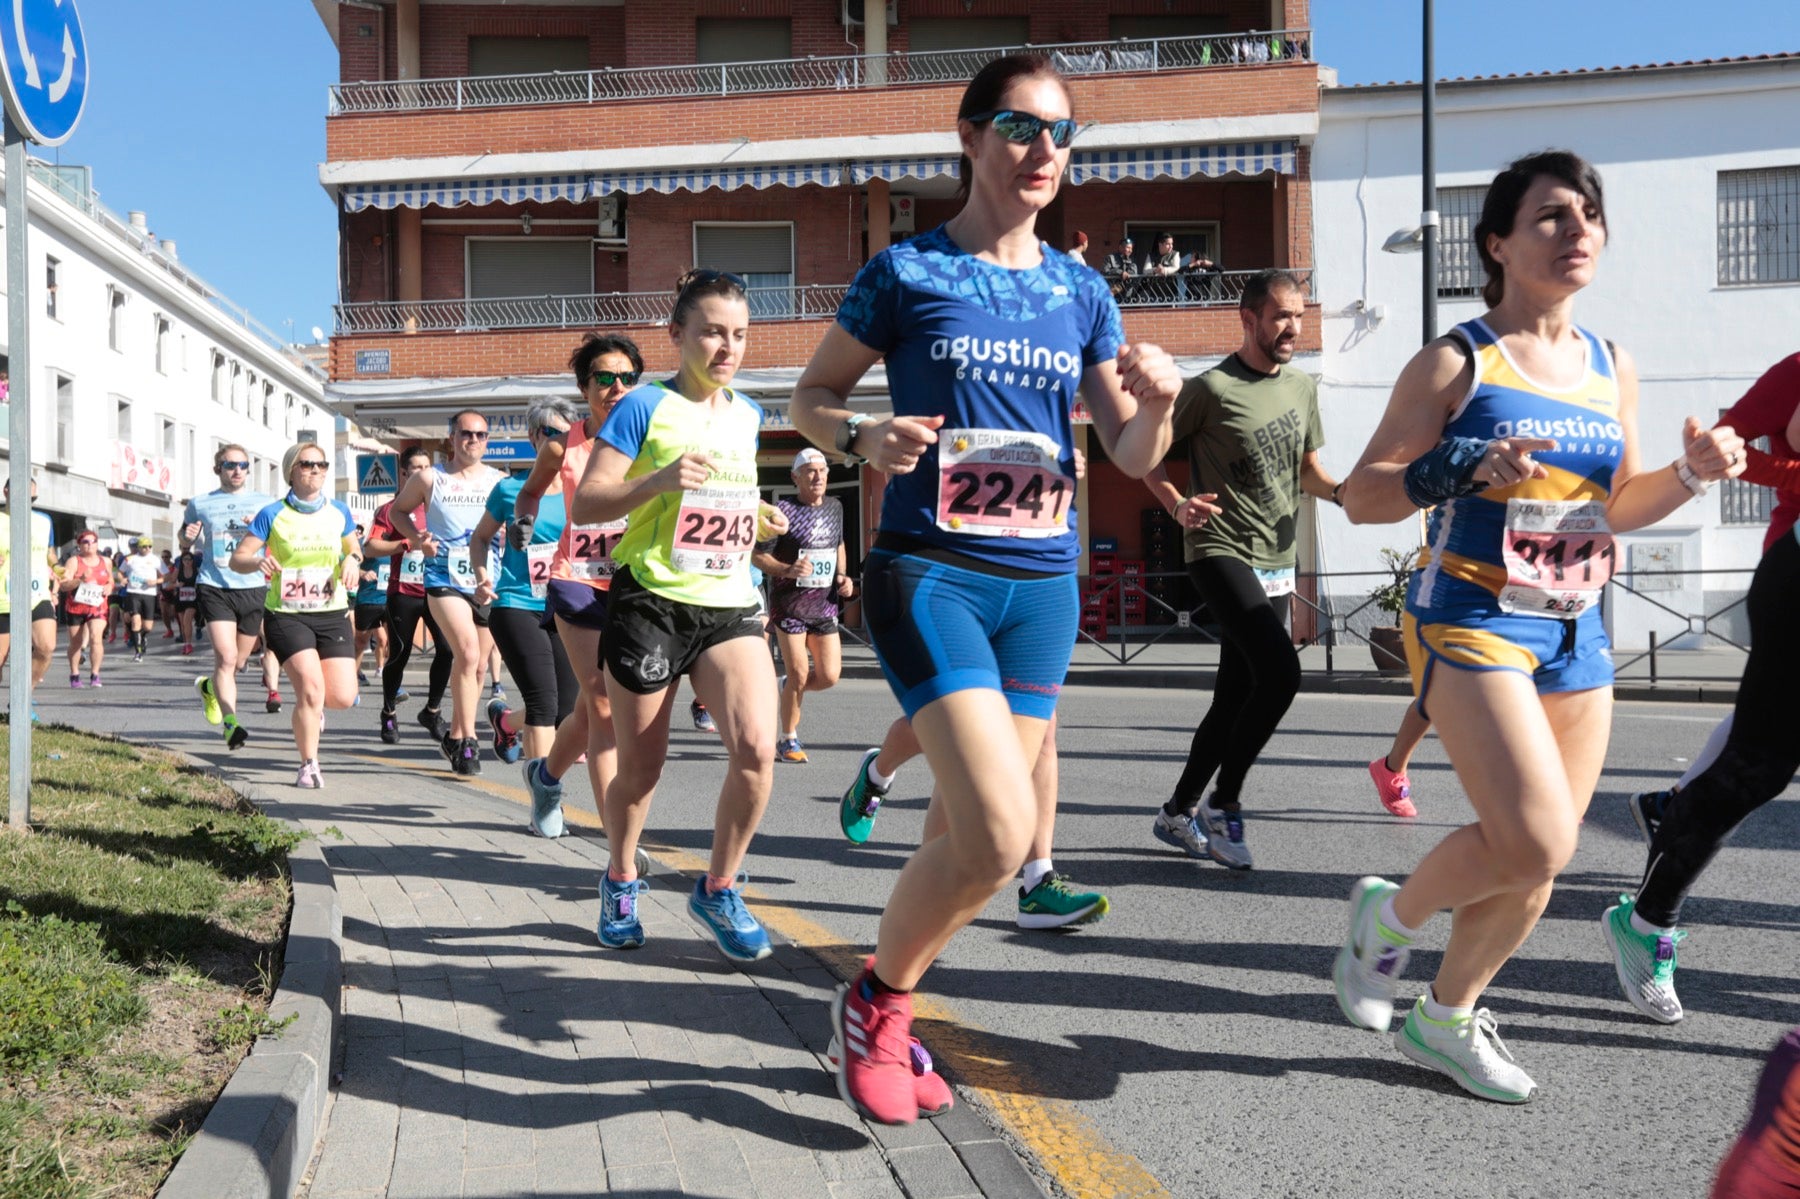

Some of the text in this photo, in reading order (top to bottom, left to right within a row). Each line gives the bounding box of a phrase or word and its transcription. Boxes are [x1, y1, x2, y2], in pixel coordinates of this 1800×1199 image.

[930, 335, 1080, 378] agustinos
[358, 364, 389, 372] CAMARERO
[956, 367, 1061, 392] GRANADA
[1254, 408, 1301, 447] BENE
[1493, 415, 1624, 442] agustino
[485, 445, 515, 456] anada
[1539, 442, 1618, 457] ANADA
[707, 471, 753, 483] ARACENA
[442, 495, 488, 504] MARACEN
[948, 471, 1065, 520] 2241
[680, 513, 754, 547] 2243
[811, 561, 832, 576] 39
[285, 581, 333, 599] 2144
